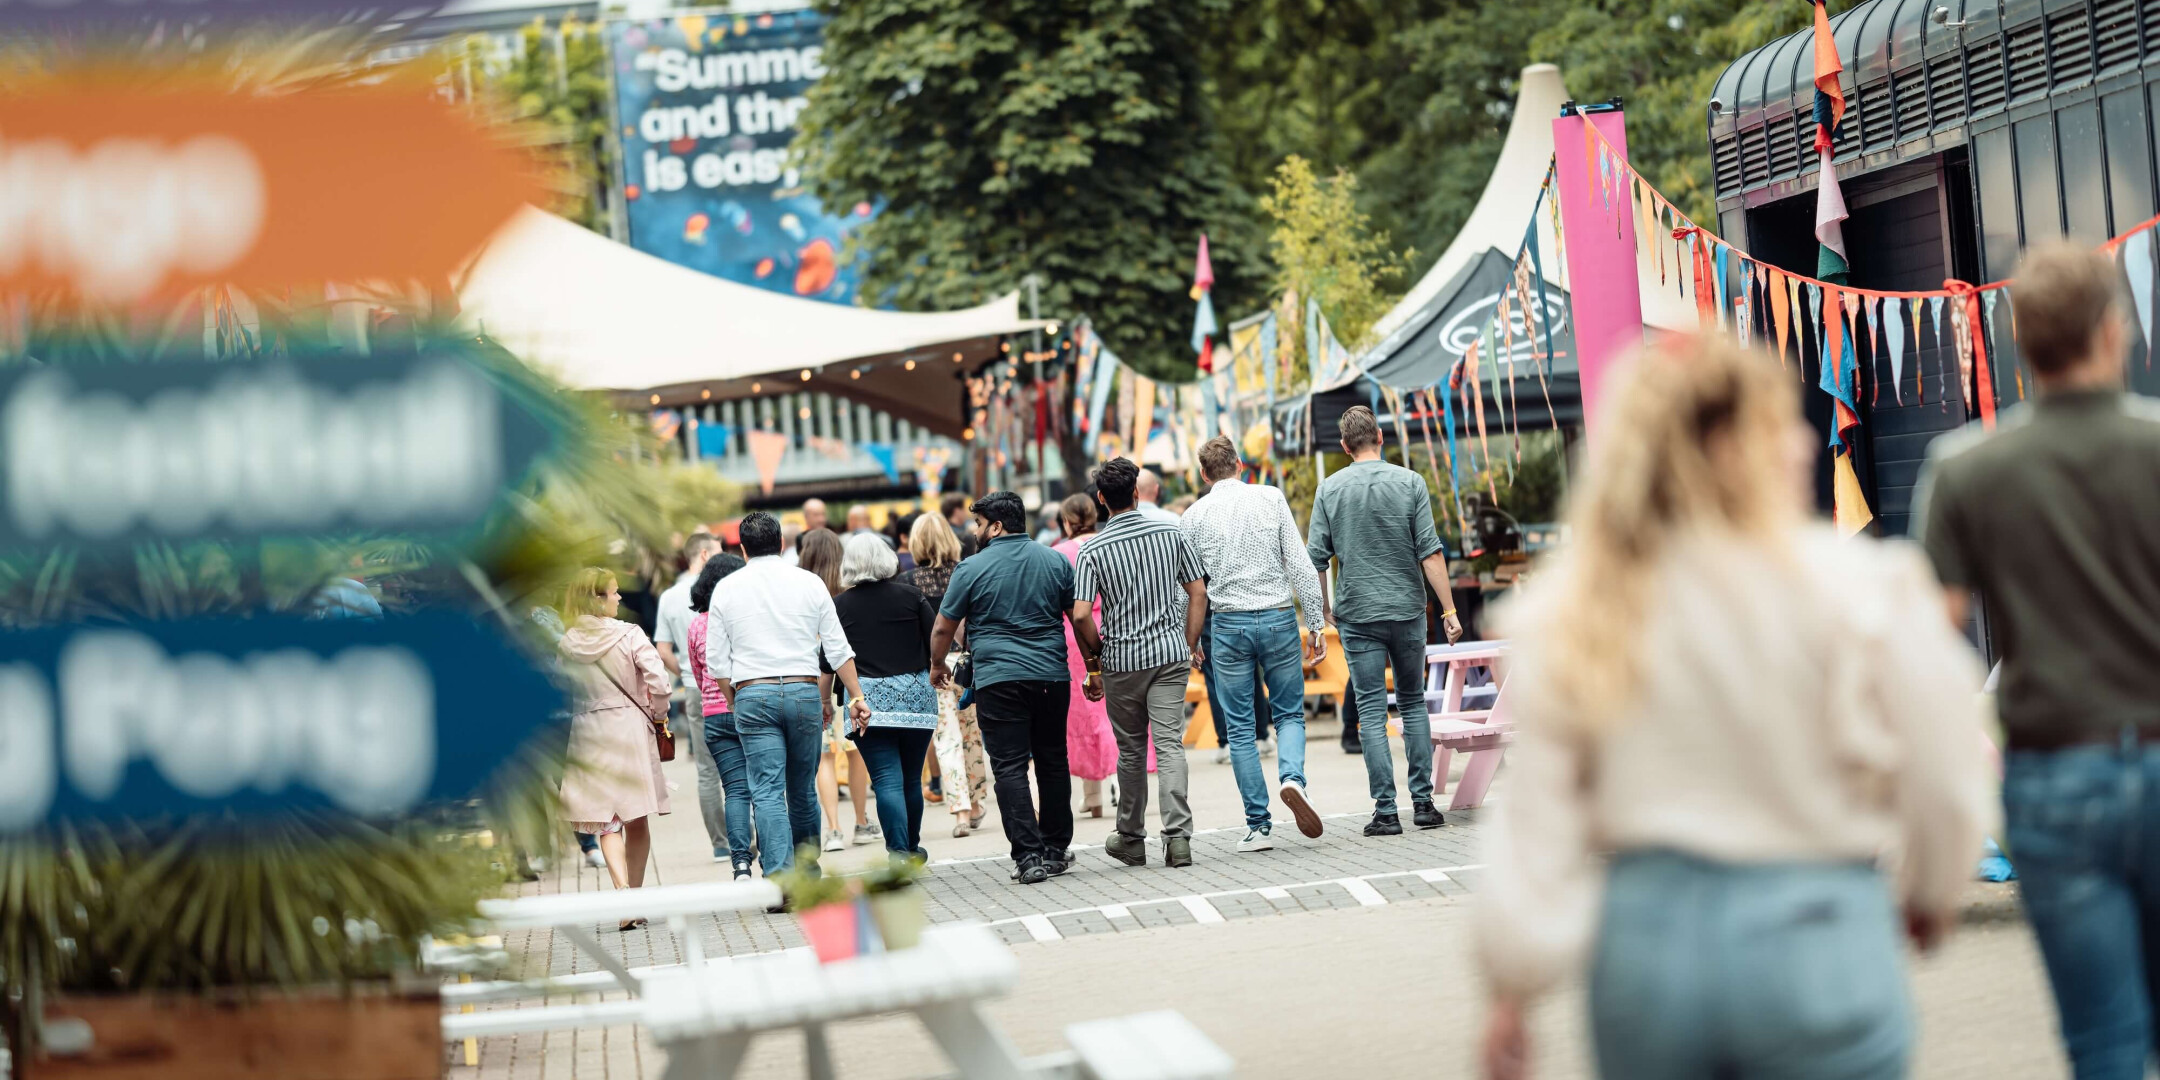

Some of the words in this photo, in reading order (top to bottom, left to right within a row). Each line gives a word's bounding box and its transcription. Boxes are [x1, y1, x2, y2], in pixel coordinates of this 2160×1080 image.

[640, 94, 730, 142] and
[643, 149, 688, 192] is
[58, 630, 433, 815] Pong
